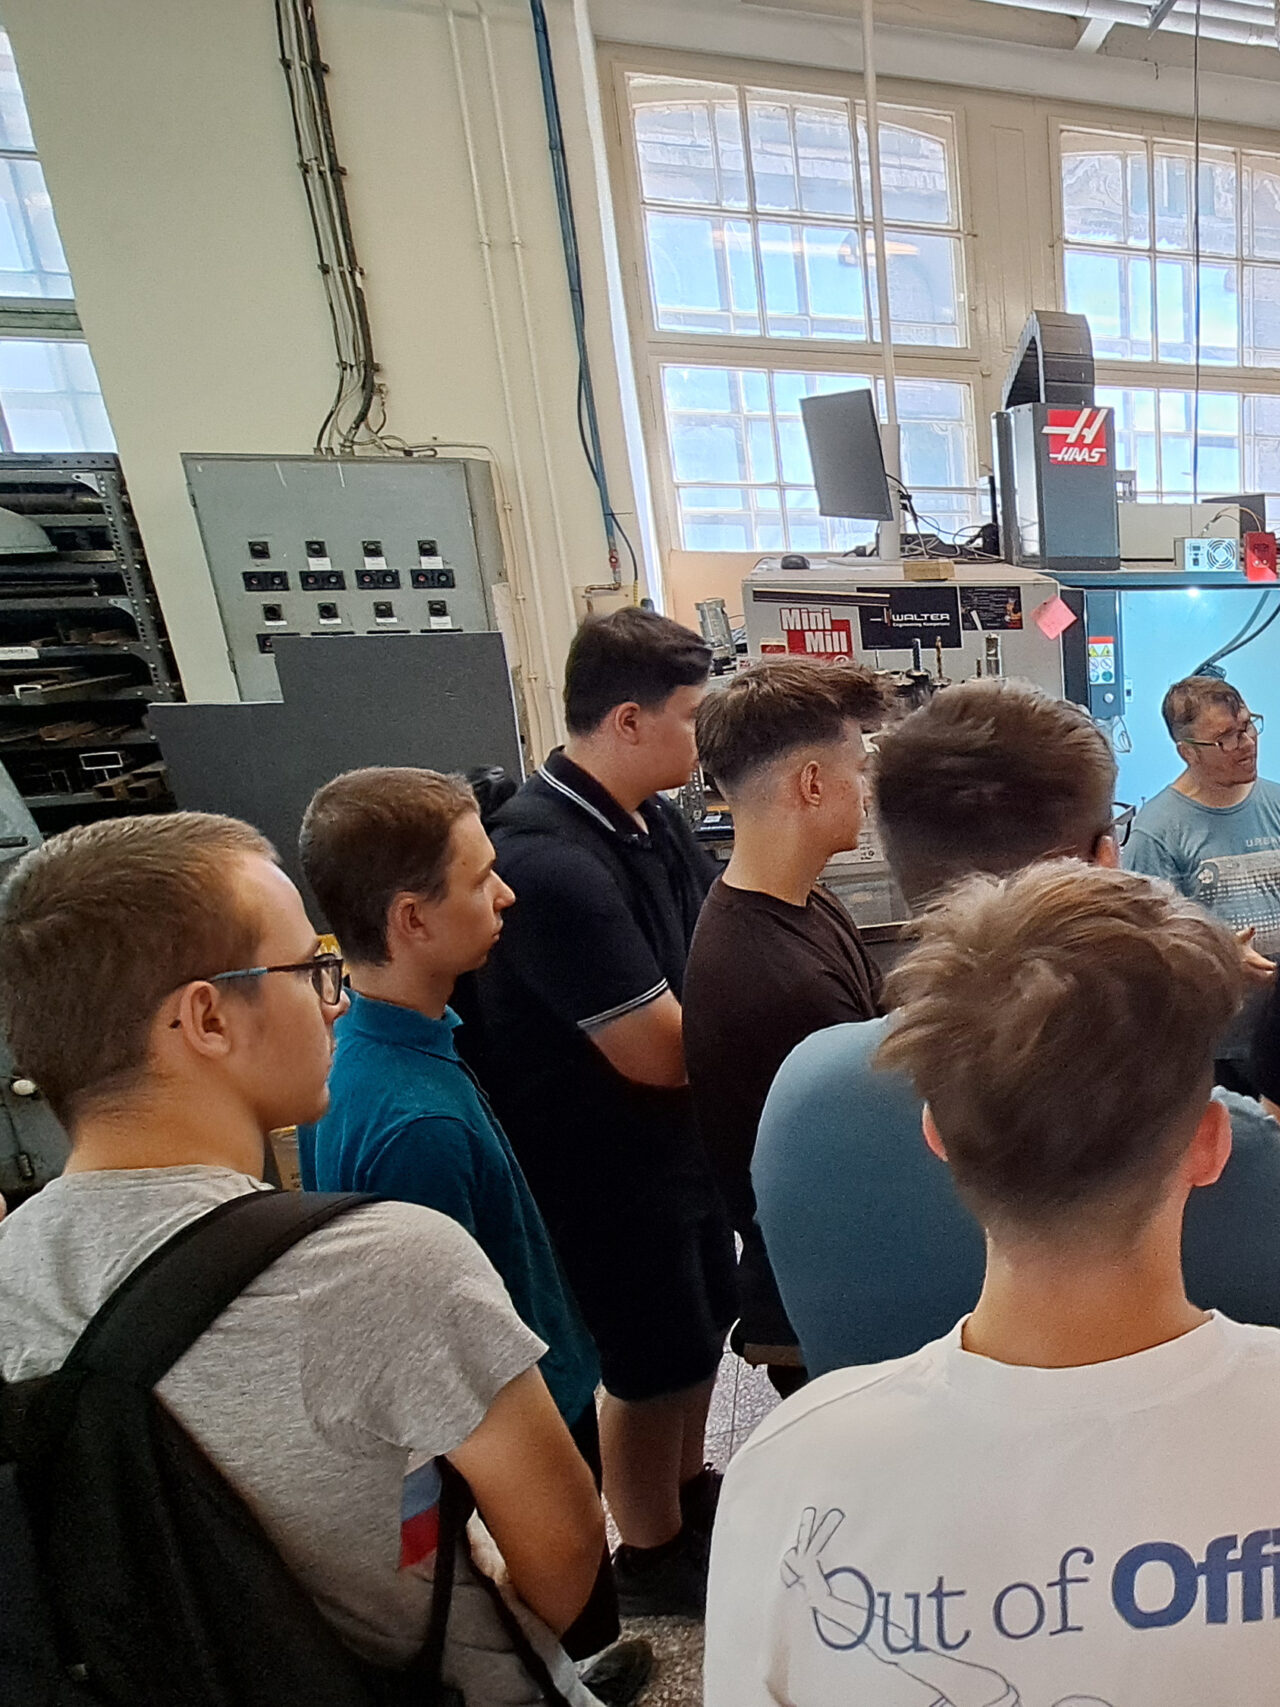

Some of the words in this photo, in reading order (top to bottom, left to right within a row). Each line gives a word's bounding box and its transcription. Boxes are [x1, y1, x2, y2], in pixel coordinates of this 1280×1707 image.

[1049, 447, 1106, 462] HAAS
[780, 608, 832, 630] Mini
[892, 613, 950, 621] WALTER
[804, 631, 847, 653] Mill
[812, 1565, 971, 1653] Out
[993, 1546, 1095, 1640] of
